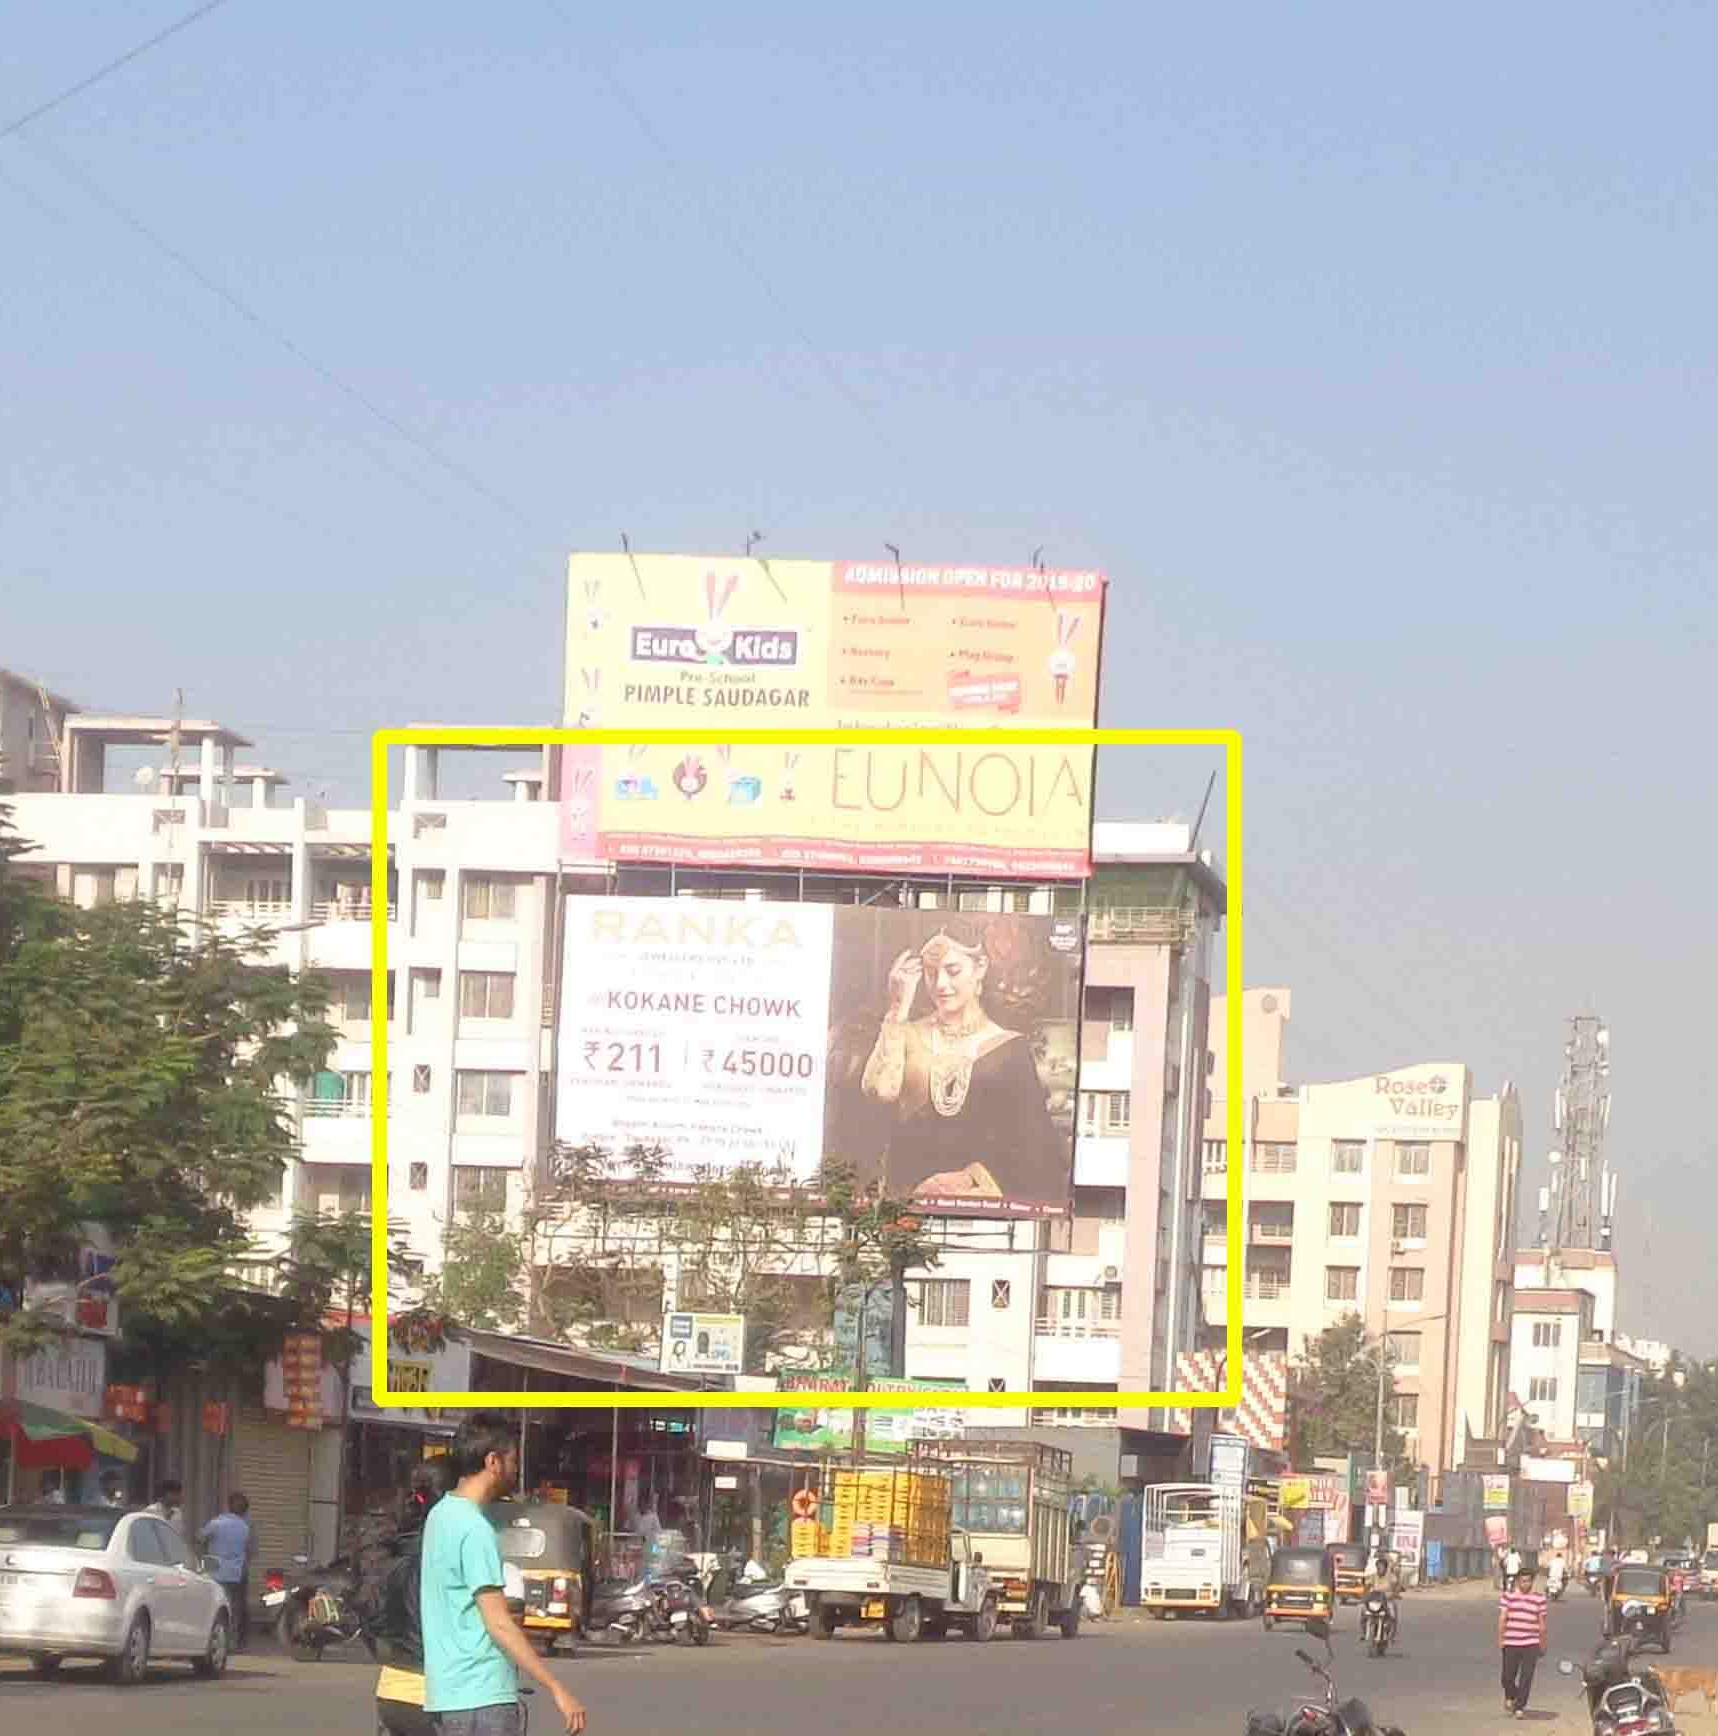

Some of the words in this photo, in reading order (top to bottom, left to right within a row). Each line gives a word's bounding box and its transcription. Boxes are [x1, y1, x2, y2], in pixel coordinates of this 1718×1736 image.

[635, 633, 696, 657] Euro
[735, 635, 793, 660] Kids
[679, 670, 756, 685] Pre-School
[623, 682, 695, 705] PIMPLE
[701, 686, 811, 709] SAUDAGAR
[830, 747, 1085, 818] EUNOIA
[591, 907, 804, 948] RANKA
[712, 994, 803, 1019] CHOWK
[1375, 1076, 1428, 1095] Rose
[1388, 1097, 1459, 1121] Valley
